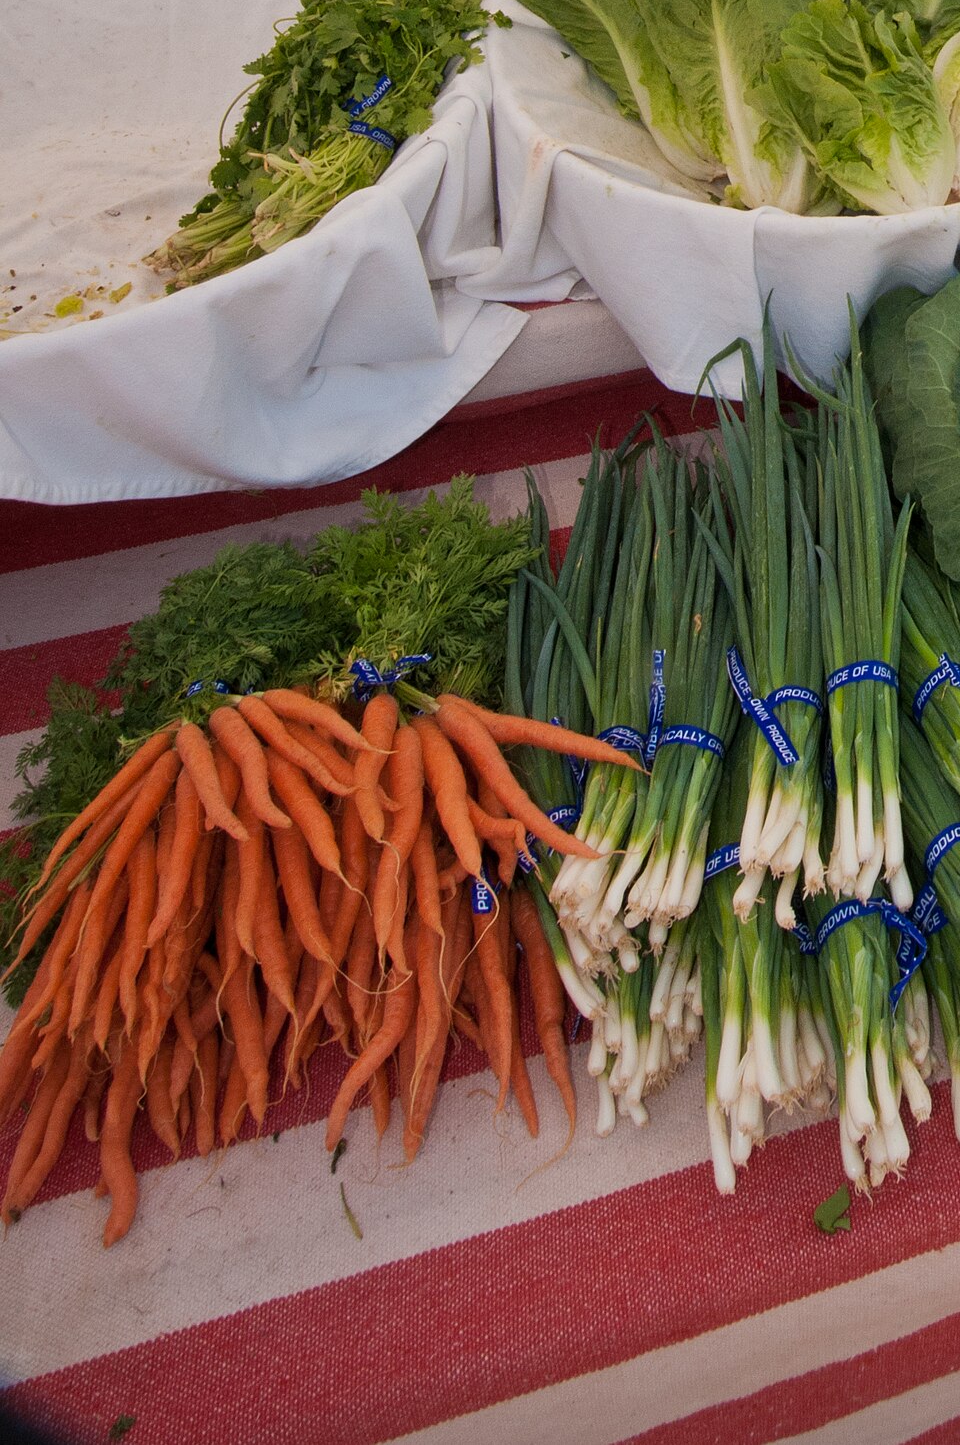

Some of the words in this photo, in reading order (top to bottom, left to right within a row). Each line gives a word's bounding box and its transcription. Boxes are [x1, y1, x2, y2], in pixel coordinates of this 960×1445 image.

[730, 649, 752, 696] PRODUCE
[852, 665, 869, 678] OF
[873, 665, 892, 680] USA
[766, 724, 797, 764] PRODUCE
[706, 855, 722, 872] OF
[817, 904, 859, 944] GROWN
